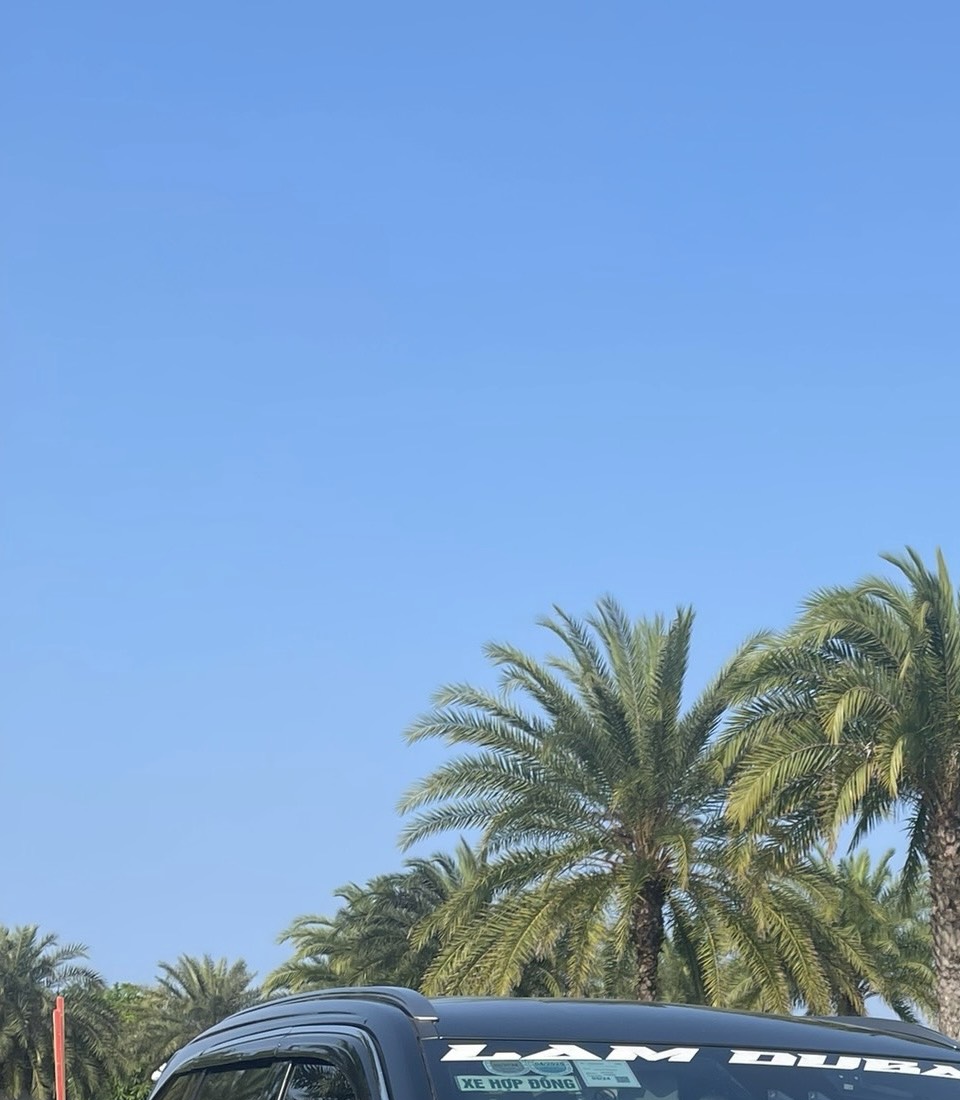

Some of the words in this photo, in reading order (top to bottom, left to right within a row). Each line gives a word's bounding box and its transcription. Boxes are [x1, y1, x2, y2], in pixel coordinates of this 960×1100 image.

[439, 1044, 699, 1063] LAM
[462, 1078, 484, 1089] XE
[491, 1079, 524, 1090] HỢP
